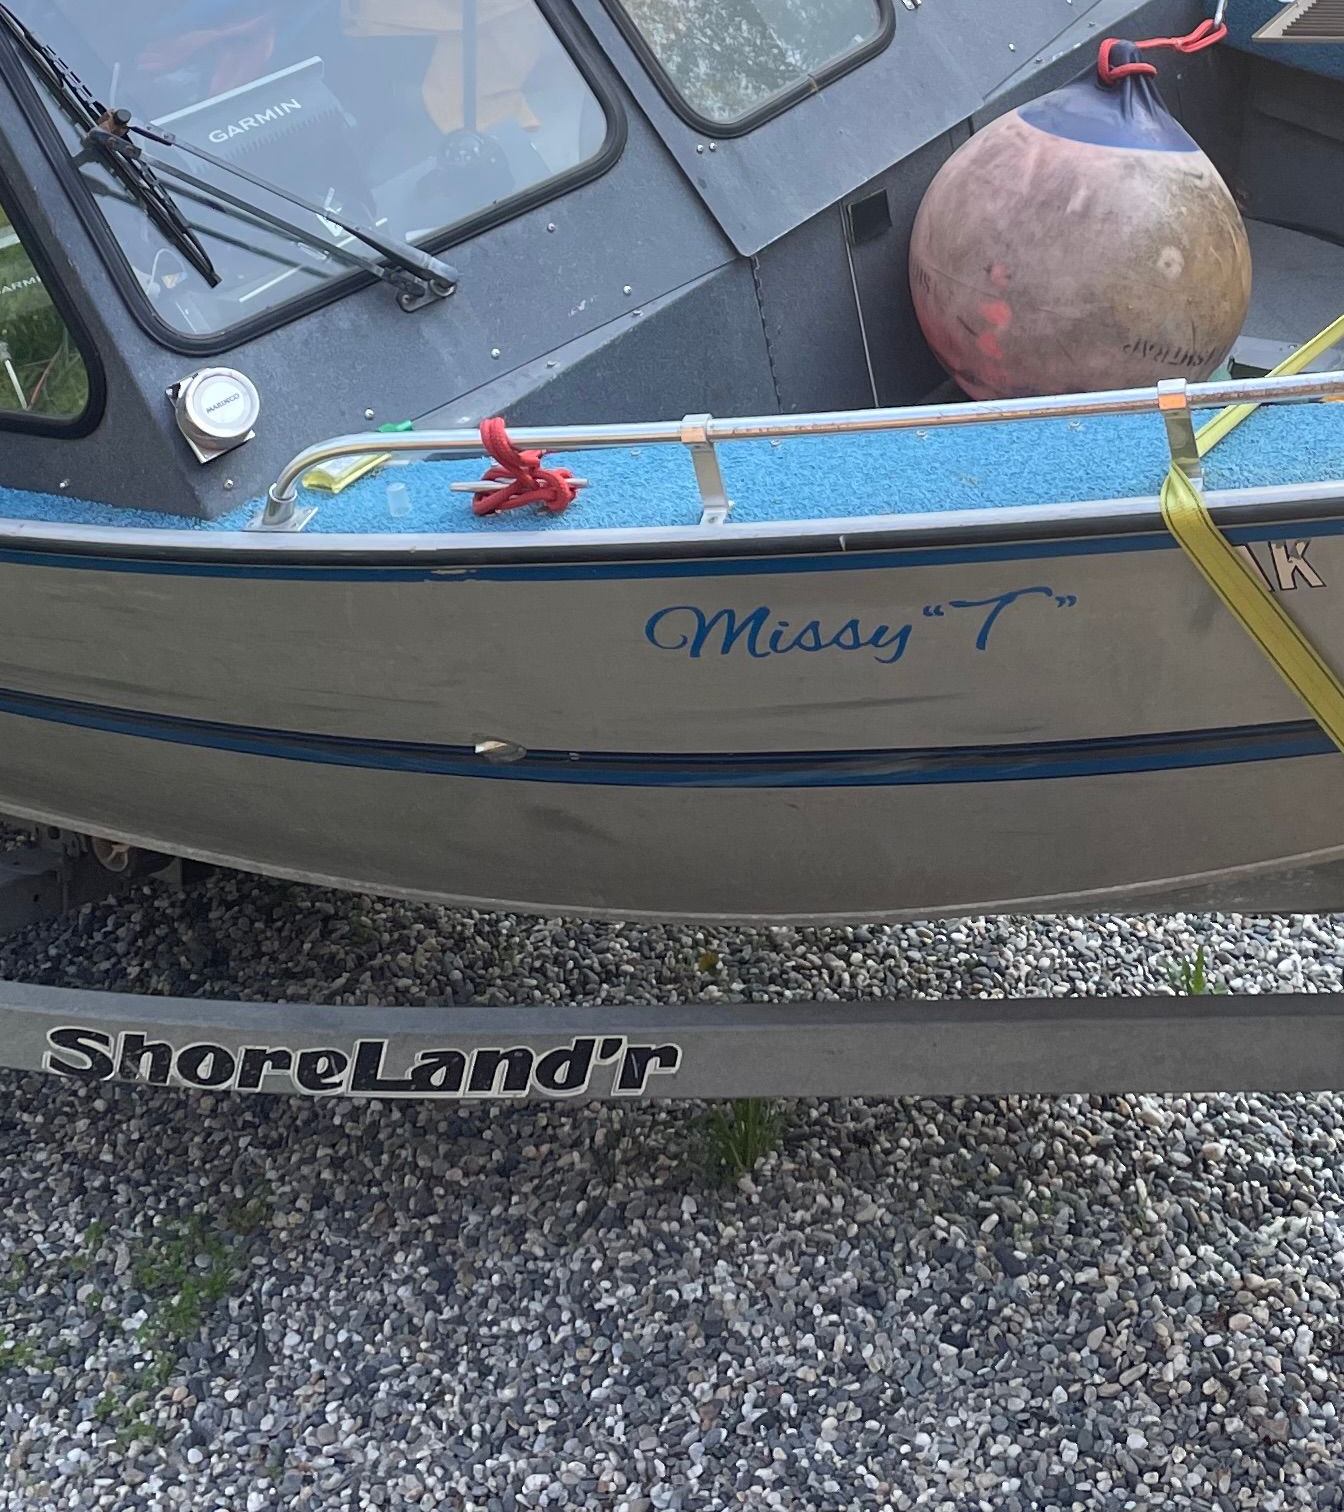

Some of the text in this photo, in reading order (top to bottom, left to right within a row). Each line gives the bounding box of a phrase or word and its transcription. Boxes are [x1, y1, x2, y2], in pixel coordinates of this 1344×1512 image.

[208, 98, 302, 143] GARMIN
[645, 605, 914, 664] Missy
[42, 1025, 682, 1099] ShoreLand'r
